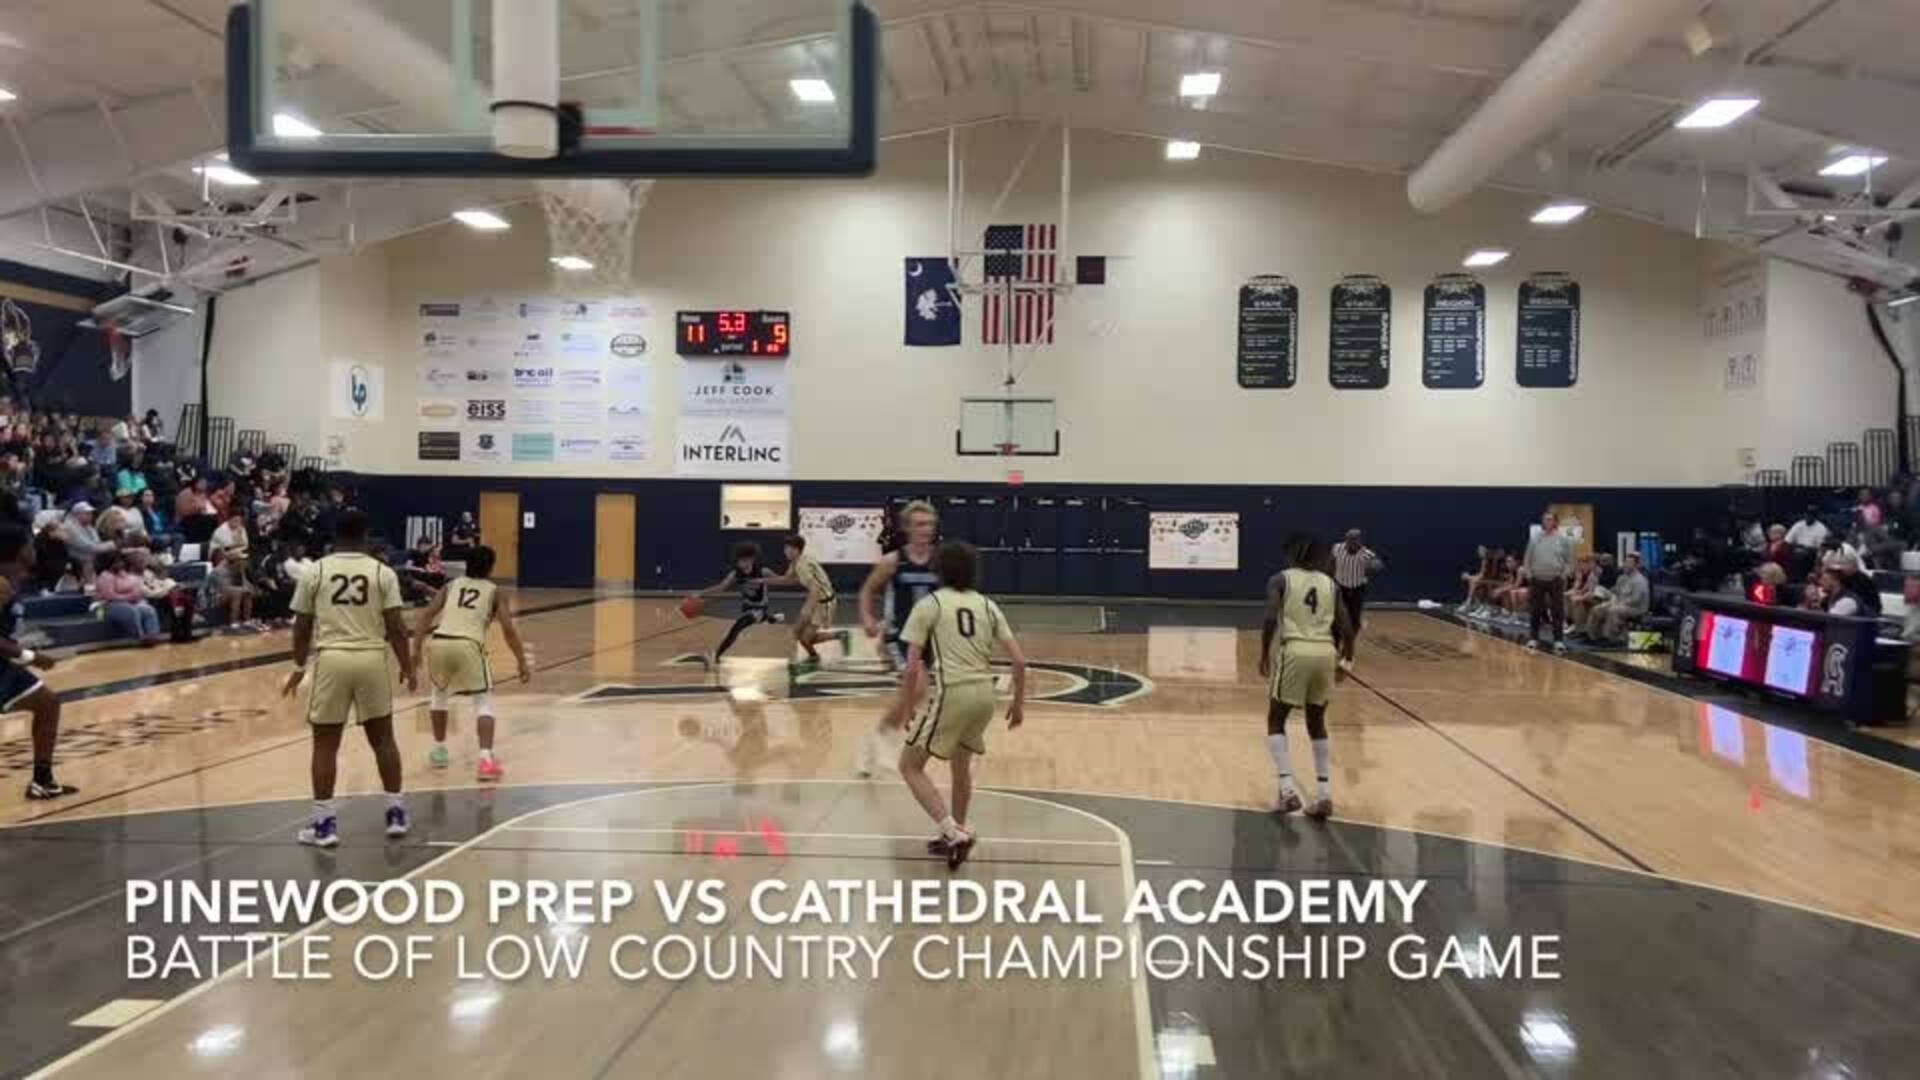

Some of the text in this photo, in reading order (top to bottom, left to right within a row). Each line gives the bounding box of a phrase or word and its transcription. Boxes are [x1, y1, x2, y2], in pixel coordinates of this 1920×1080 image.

[687, 323, 705, 343] 11
[773, 323, 787, 343] 9
[695, 384, 774, 396] JEFF COOK
[682, 444, 782, 462] INTERLINC
[329, 573, 370, 606] 23
[457, 586, 481, 609] 12
[1303, 586, 1319, 615] 4
[955, 606, 976, 639] 0
